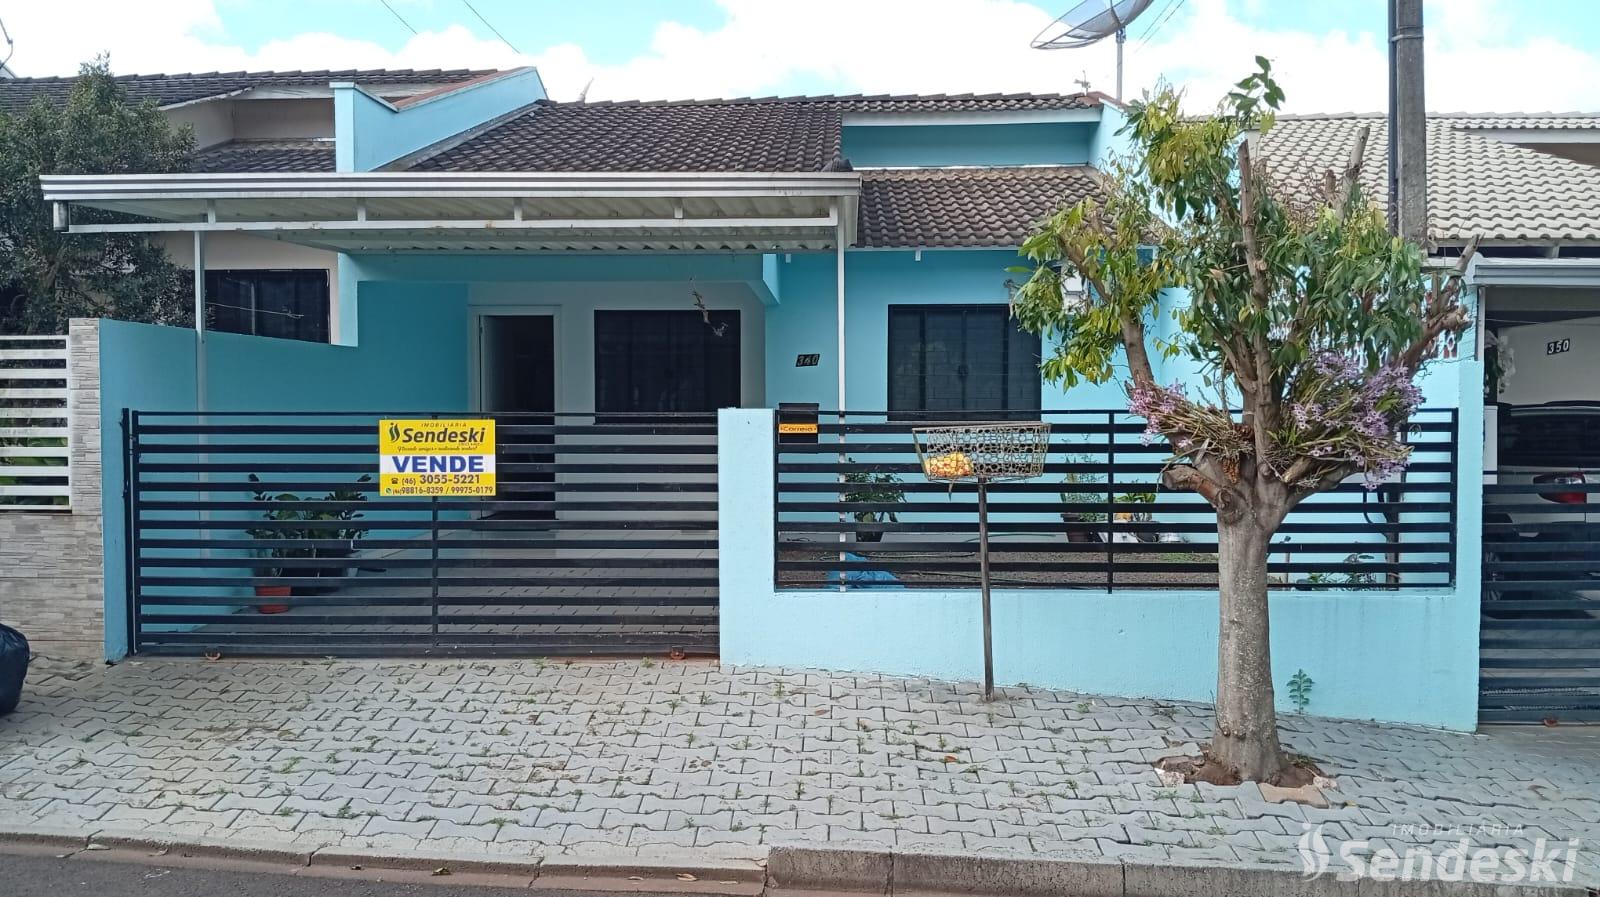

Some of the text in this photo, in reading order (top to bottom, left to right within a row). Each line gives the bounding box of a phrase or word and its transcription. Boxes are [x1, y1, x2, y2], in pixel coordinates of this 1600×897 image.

[1548, 340, 1570, 354] 350
[402, 428, 485, 443] Sendeski
[392, 456, 484, 473] VENDE
[401, 475, 480, 486] (46) 3055-5221
[451, 487, 493, 495] 99975-0179
